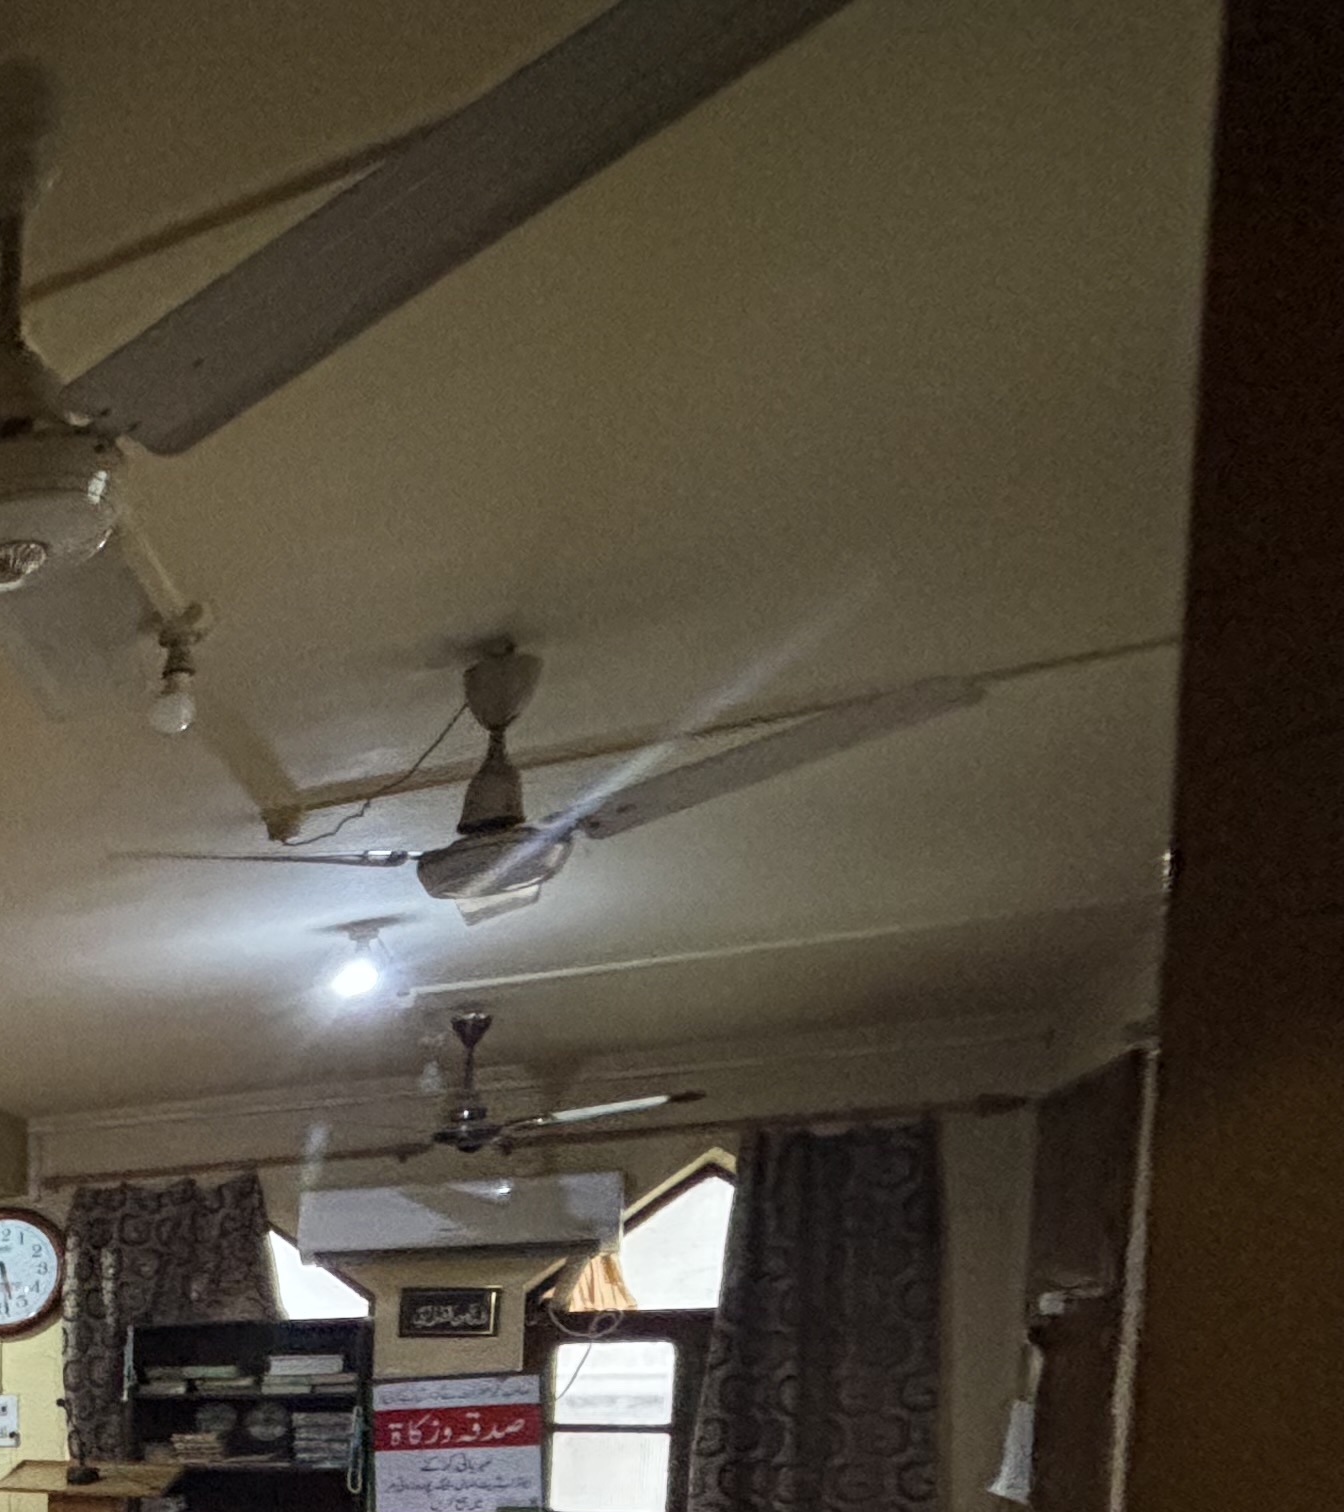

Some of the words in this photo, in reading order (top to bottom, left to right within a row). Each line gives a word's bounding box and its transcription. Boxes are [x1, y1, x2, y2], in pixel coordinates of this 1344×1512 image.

[19, 1231, 25, 1245] 1
[32, 1244, 43, 1258] 2
[37, 1262, 48, 1275] 3
[30, 1280, 40, 1293] 4
[16, 1294, 28, 1309] 5
